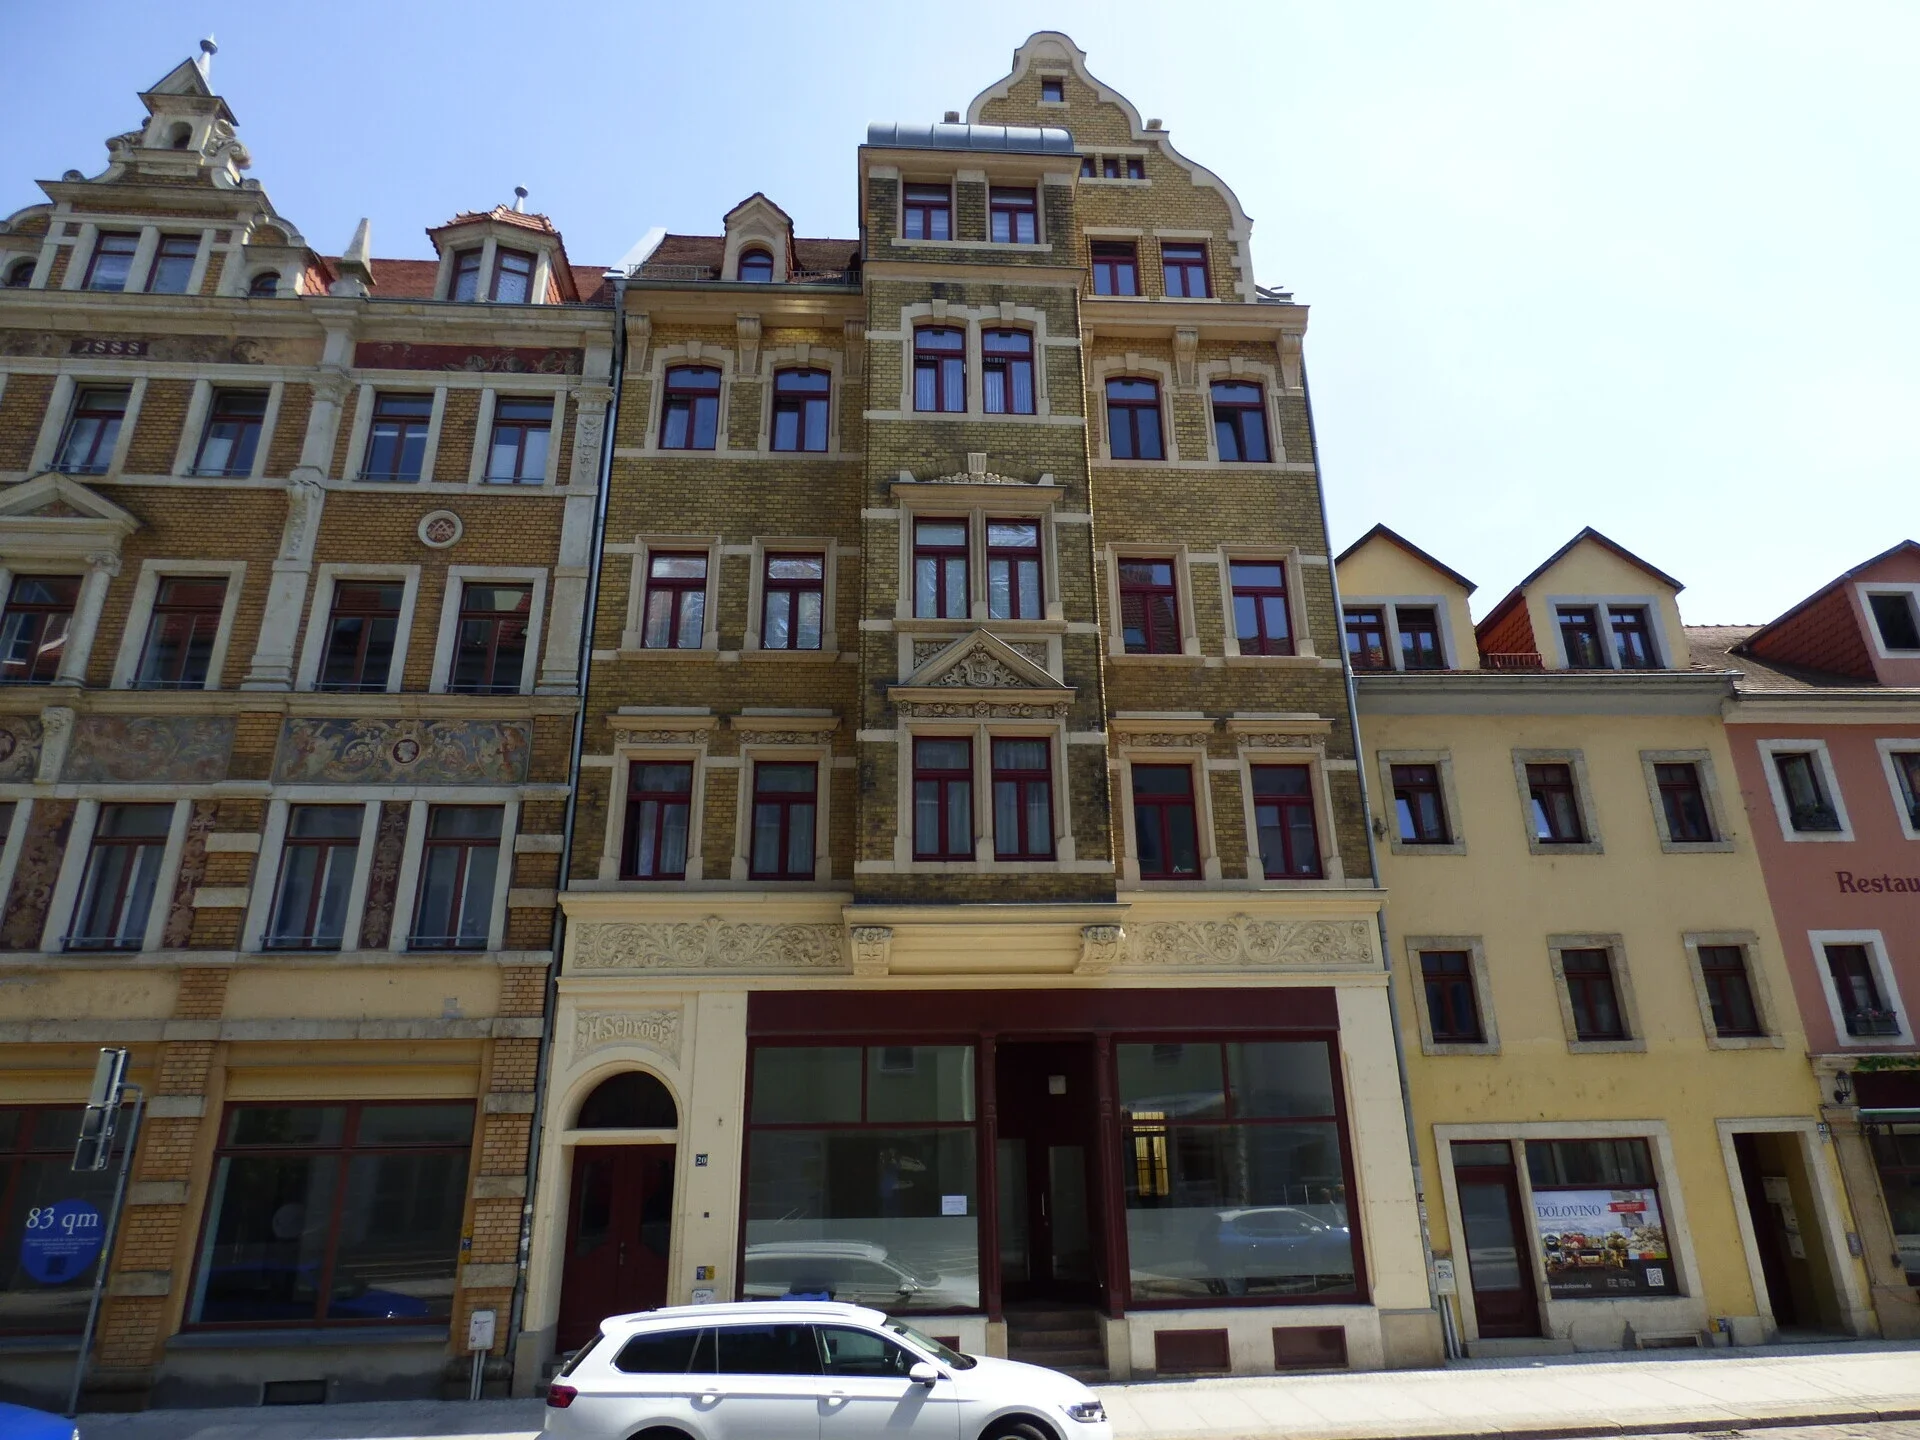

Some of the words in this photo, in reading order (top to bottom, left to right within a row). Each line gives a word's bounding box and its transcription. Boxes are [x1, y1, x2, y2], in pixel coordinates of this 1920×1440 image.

[1834, 871, 1920, 893] Restau
[697, 1156, 707, 1164] 20
[1537, 1204, 1601, 1217] DOLOVINO
[26, 1207, 55, 1229] 83
[62, 1213, 98, 1235] qm
